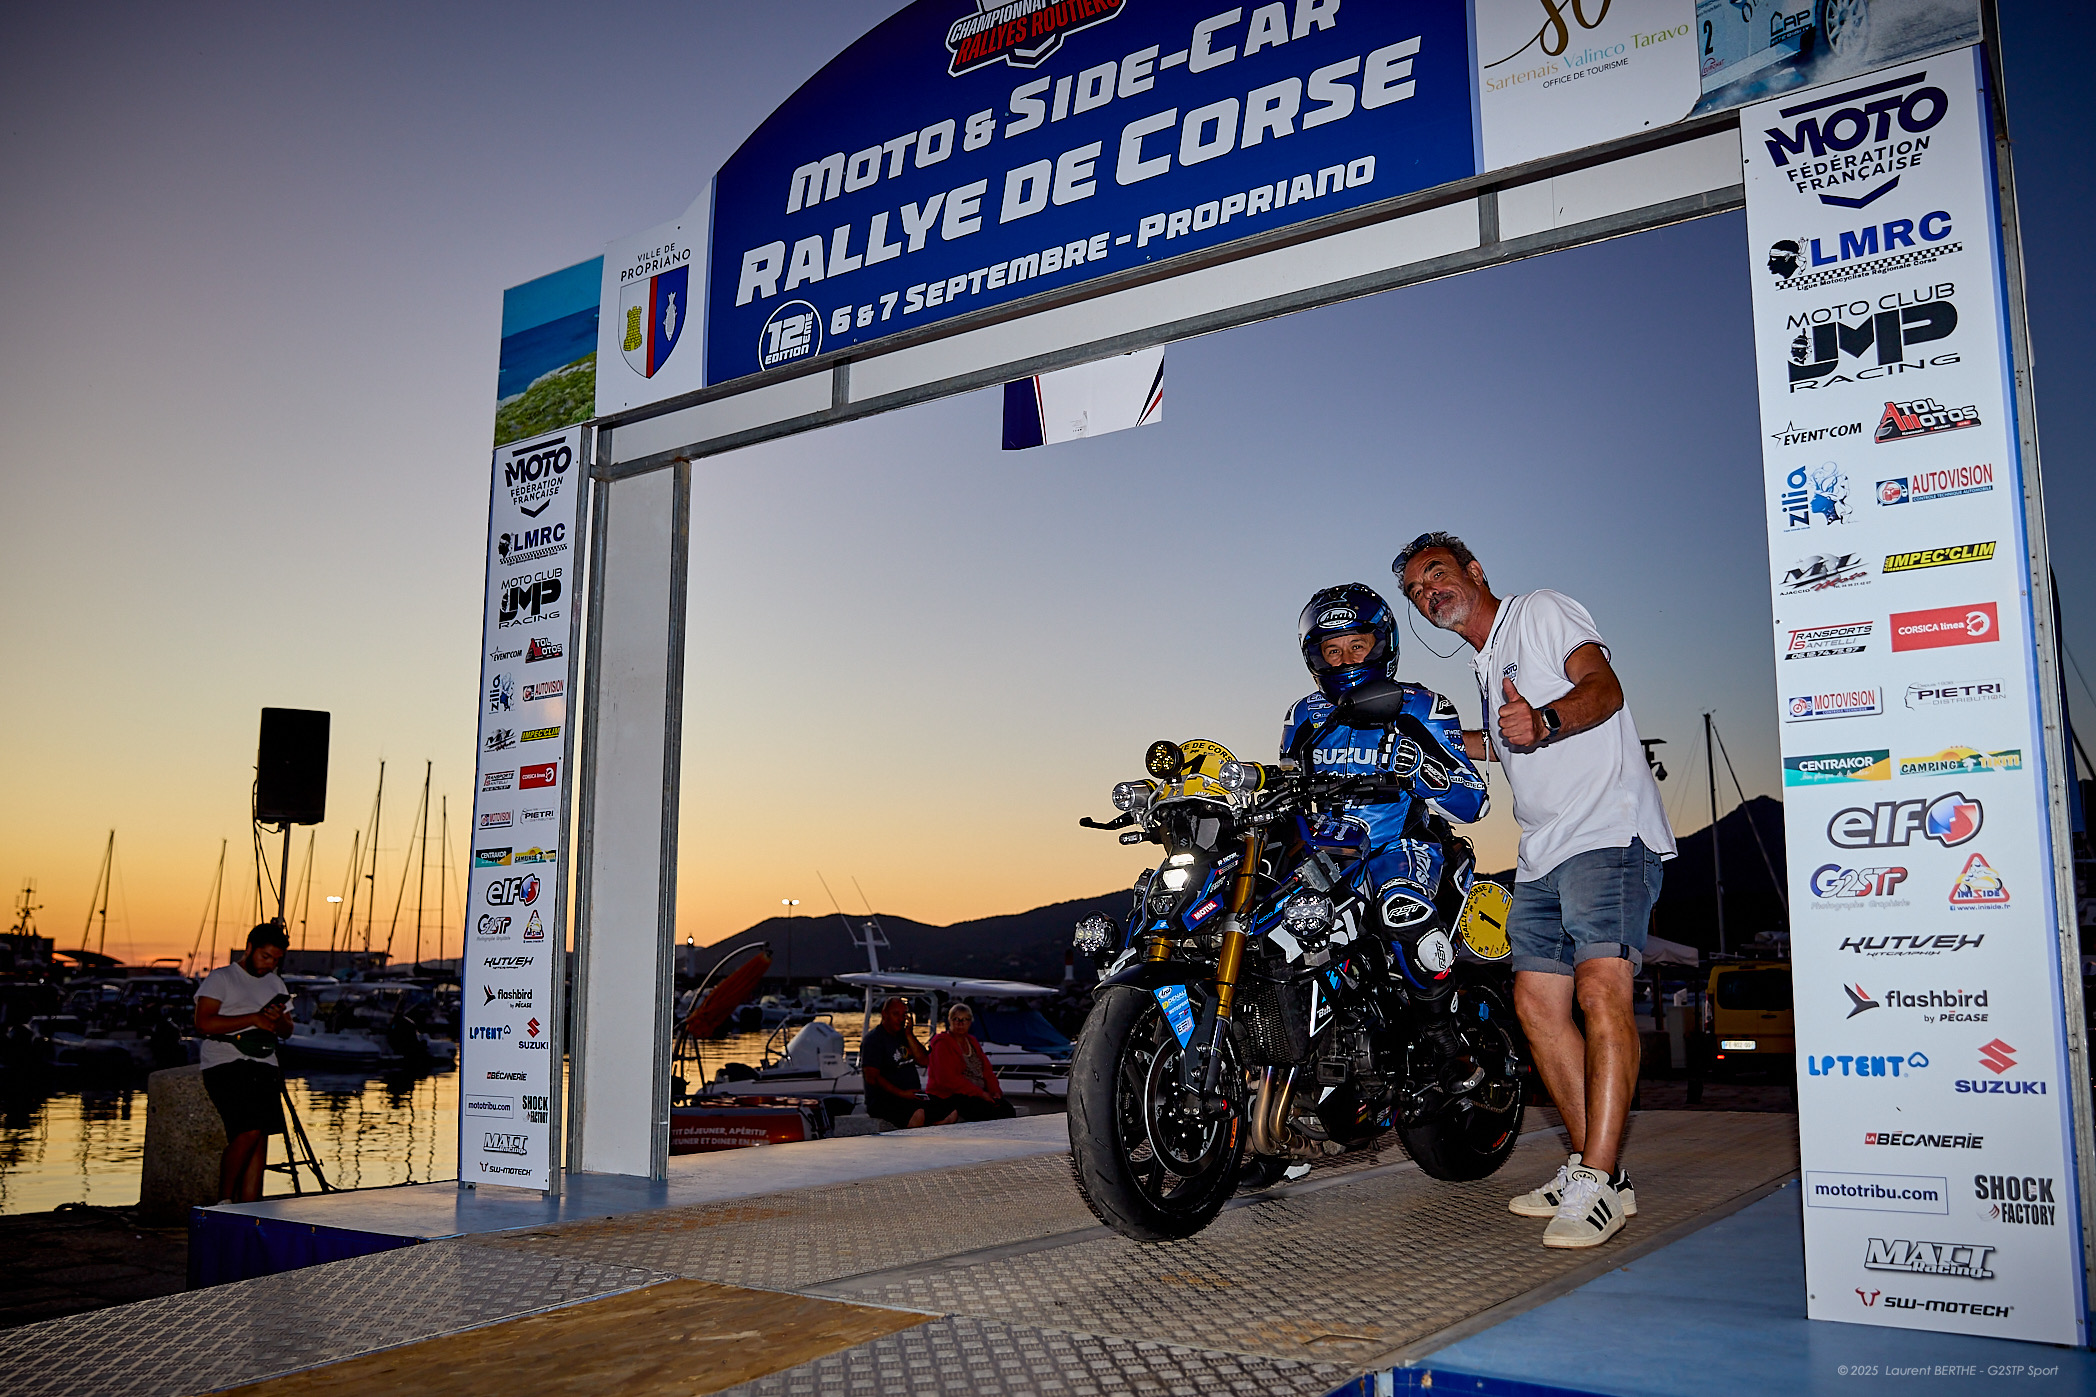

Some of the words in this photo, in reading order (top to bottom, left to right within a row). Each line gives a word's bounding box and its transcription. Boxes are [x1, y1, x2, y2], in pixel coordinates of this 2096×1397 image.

[956, 17, 1027, 65] RALLYES
[1486, 61, 1559, 93] Sartenais
[1563, 43, 1625, 69] Valinco
[1631, 24, 1689, 50] Taravo
[1542, 74, 1571, 89] OFFICE
[1573, 71, 1585, 80] DE
[1587, 57, 1629, 77] TOURISME
[786, 118, 957, 214] MOTO
[963, 111, 993, 152] &
[1004, 0, 1340, 140] SIDE-CAR
[1764, 86, 1948, 168] MOTO
[1786, 136, 1931, 182] FÉDÉRATION
[735, 180, 988, 307] RALLYE
[1000, 140, 1101, 224] DE
[1115, 35, 1421, 187] CORSE
[1796, 153, 1923, 193] FRANÇAISE
[830, 305, 853, 335] 6
[856, 304, 874, 327] &
[880, 291, 898, 321] 7
[903, 231, 1109, 315] SEPTEMBRE
[1136, 155, 1375, 248] PROPRIANO
[1810, 210, 1952, 268] LMRC
[637, 247, 661, 263] VILLE
[664, 242, 676, 254] DE
[1914, 257, 1937, 266] Corse
[620, 248, 691, 282] PROPRIANO
[1786, 300, 1869, 330] MOTO
[1879, 282, 1954, 310] CLUB
[768, 314, 806, 354] 12
[1788, 301, 1958, 382] JMP
[765, 343, 810, 365] EDITION
[1790, 353, 1960, 393] RACING
[1881, 398, 1945, 431] ATOL
[504, 446, 572, 487] MOTO
[510, 476, 563, 498] FÉDÉRATION
[1912, 463, 1993, 494] AUTOVISION
[513, 486, 560, 506] FRANÇAISE
[514, 522, 566, 551] LMRC
[501, 575, 532, 590] MOTO
[534, 568, 562, 582] CLUB
[499, 578, 561, 622] JMP
[1780, 588, 1811, 596] AJACCIO
[499, 610, 560, 630] RACING
[1897, 624, 1938, 636] CORSICA
[1940, 621, 1964, 631] linea
[528, 637, 551, 657] ATOL
[1793, 638, 1856, 650] SANTELLI
[535, 680, 565, 696] AUTOVISION
[1918, 683, 2000, 700] PIETRI
[1814, 690, 1875, 710] MOTOVISION
[1933, 693, 2006, 706] DISTRIBUTION
[1208, 744, 1233, 763] CORS
[1313, 747, 1378, 765] SUZU
[1799, 756, 1874, 772] CENTRAKOR
[1901, 760, 1956, 773] CAMPING
[1979, 755, 2019, 768] TIKITI
[525, 810, 554, 819] PIETRI
[1827, 799, 1926, 849] elf
[481, 851, 507, 859] CENTRAKOR
[1810, 863, 1908, 898] G2STP
[486, 877, 522, 906] elf
[1193, 903, 1217, 920] MOTUL
[1479, 910, 1501, 930] 1
[477, 914, 511, 935] G2STP
[498, 988, 532, 1000] flashbird
[1885, 988, 1988, 1008] flashbird
[1924, 1014, 1935, 1024] by
[469, 1027, 503, 1040] LPTENT
[518, 1041, 549, 1050] SUZUKI
[1808, 1055, 1905, 1077] LPTENT
[1954, 1079, 2047, 1095] SUZUKI
[468, 1101, 511, 1111] mototribu.com
[522, 1095, 548, 1111] SHOCK
[530, 1111, 548, 1124] FACTORY
[489, 1165, 531, 1177] SW-MOTECH
[1815, 1182, 1938, 1202] mototribu.com
[1974, 1174, 2055, 1203] SHOCK
[2002, 1204, 2055, 1226] FACTORY
[1866, 1238, 1996, 1265] MATT
[1911, 1261, 1985, 1279] Racing
[1884, 1295, 2010, 1318] SW-MOTECH
